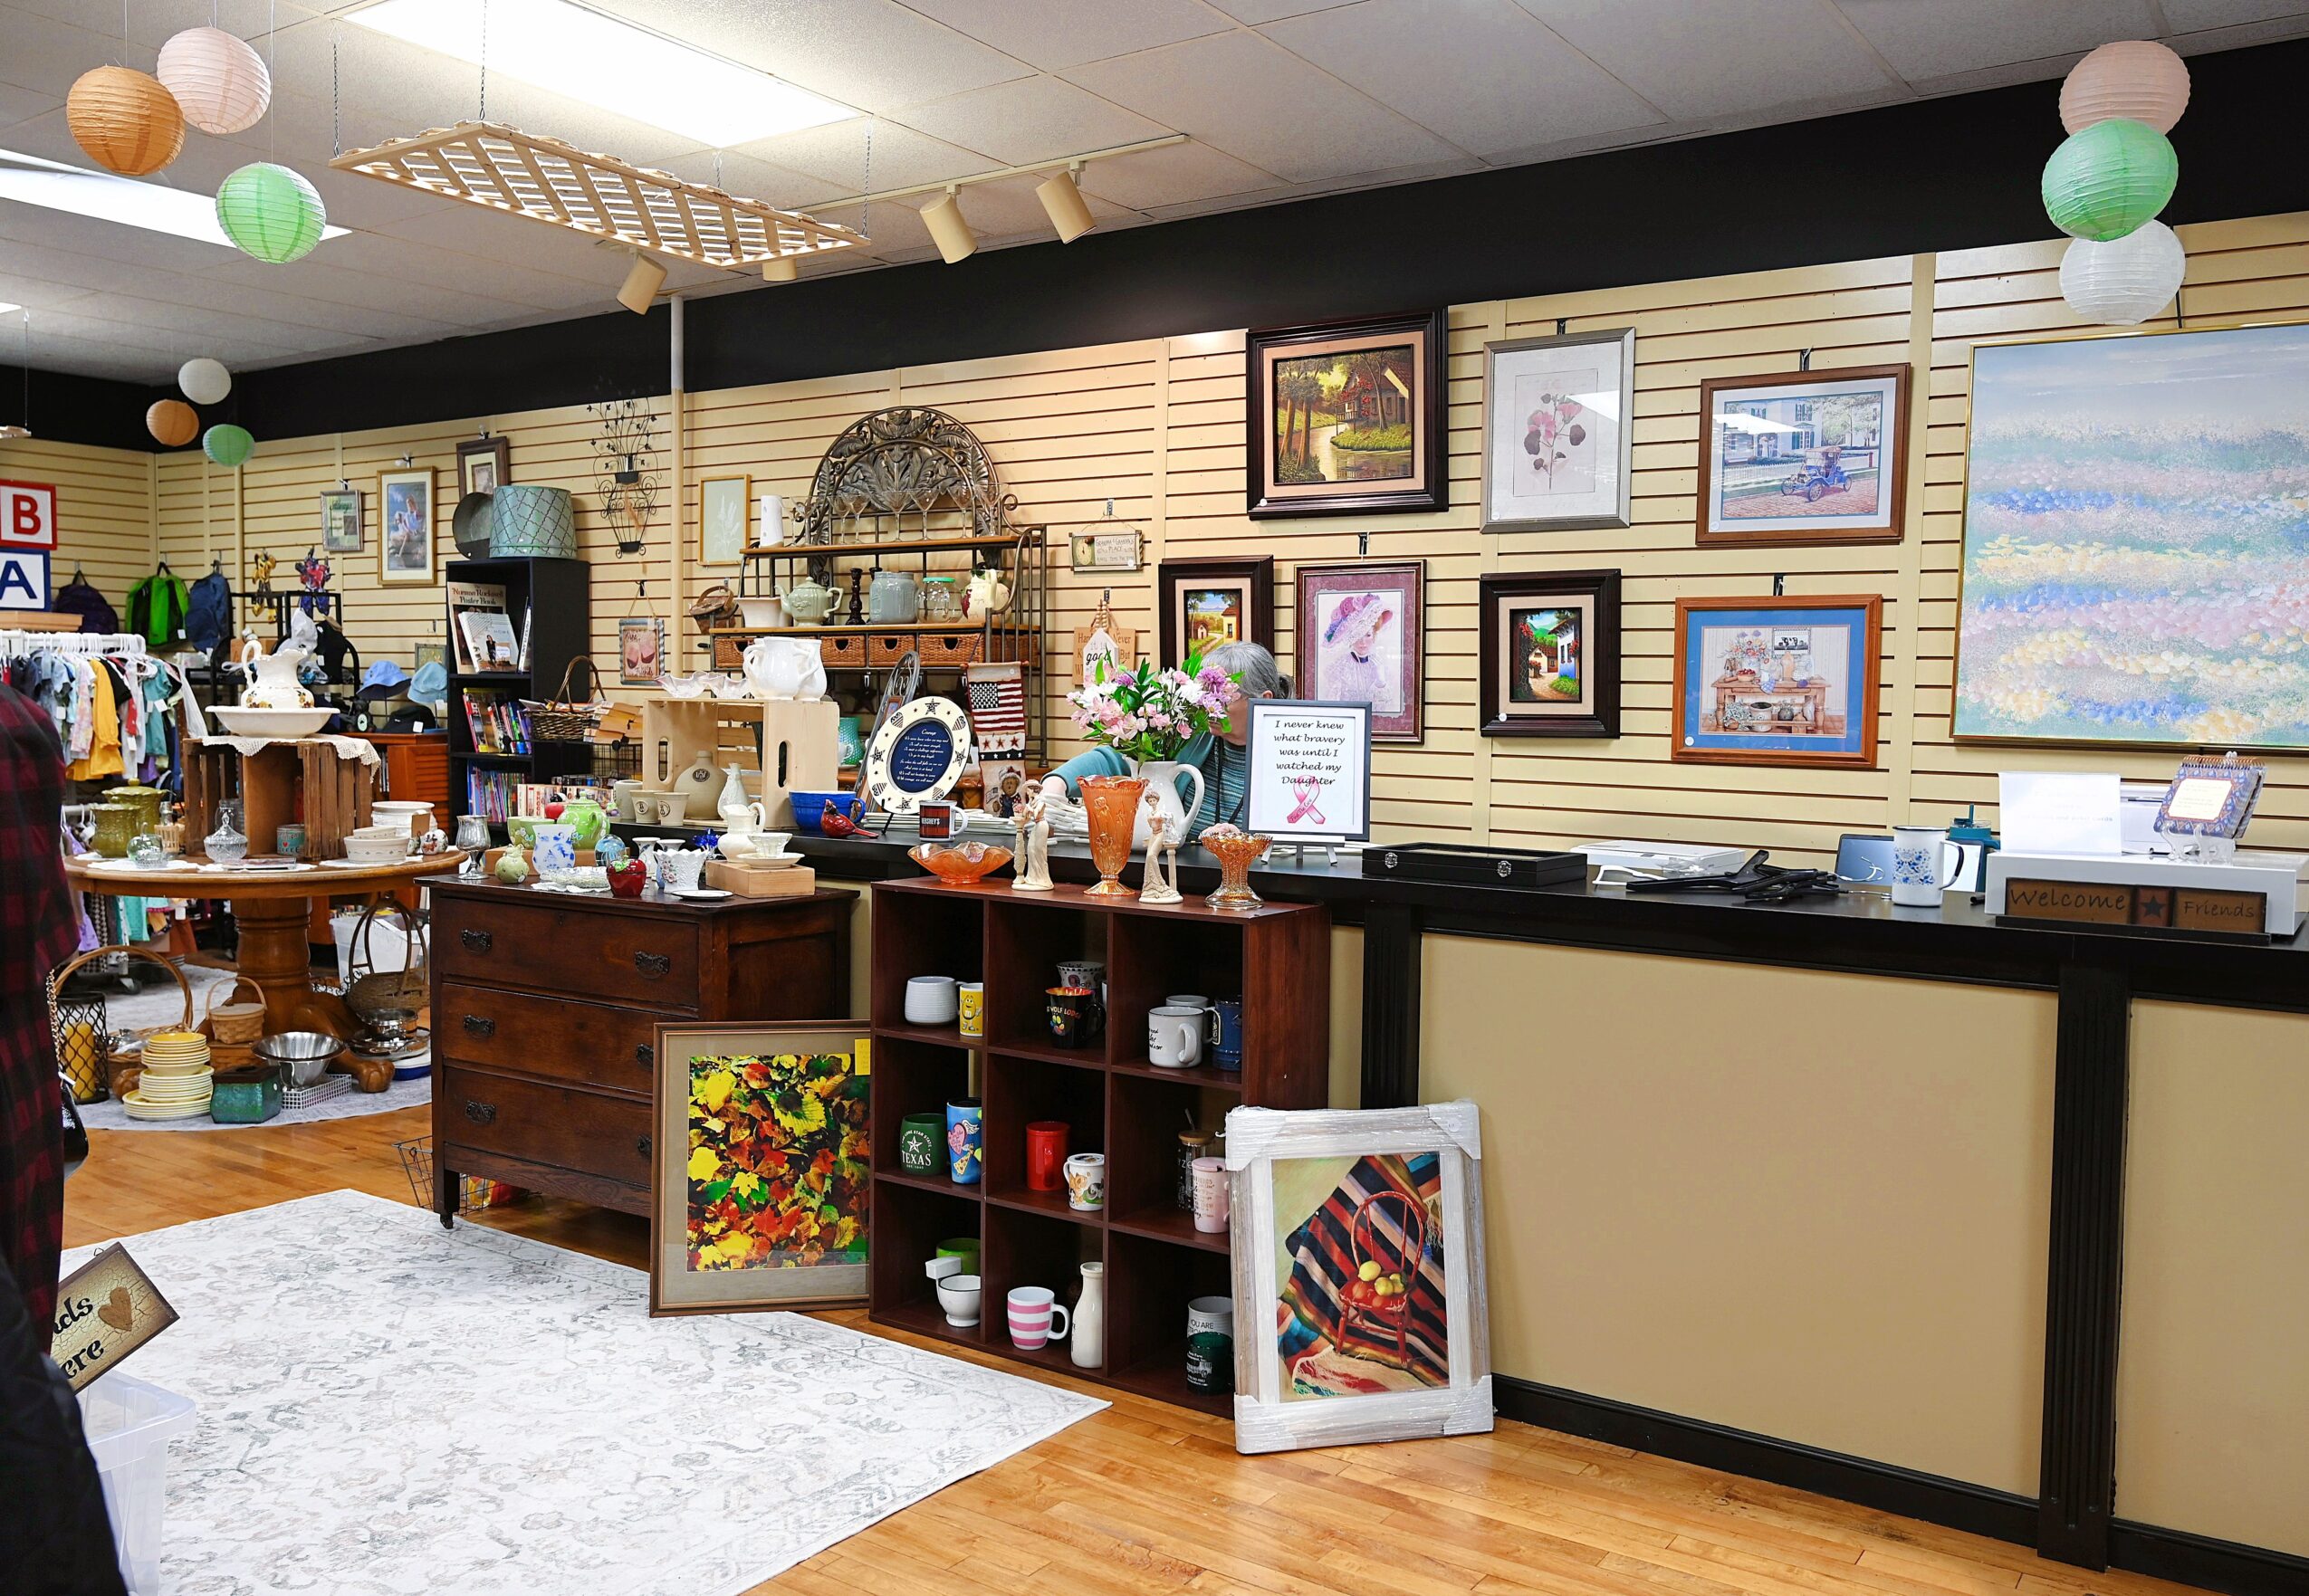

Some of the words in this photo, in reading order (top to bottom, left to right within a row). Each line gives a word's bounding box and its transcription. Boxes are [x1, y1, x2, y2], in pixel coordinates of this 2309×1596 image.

[13, 493, 41, 535] B
[0, 560, 37, 599] A
[452, 588, 476, 596] Norman
[460, 596, 479, 604] Poster
[1316, 721, 1344, 730] knew
[1274, 733, 1302, 741] what
[1304, 734, 1346, 745] bravery
[1302, 749, 1331, 757] until
[1333, 749, 1338, 757] I
[1276, 761, 1323, 771] watched
[1326, 764, 1341, 773] my
[1281, 777, 1336, 787] Daughter
[2010, 888, 2125, 911] Welcome
[2183, 901, 2256, 919] Friends
[924, 1135, 933, 1147] STATE
[901, 1150, 932, 1166] TEXAS
